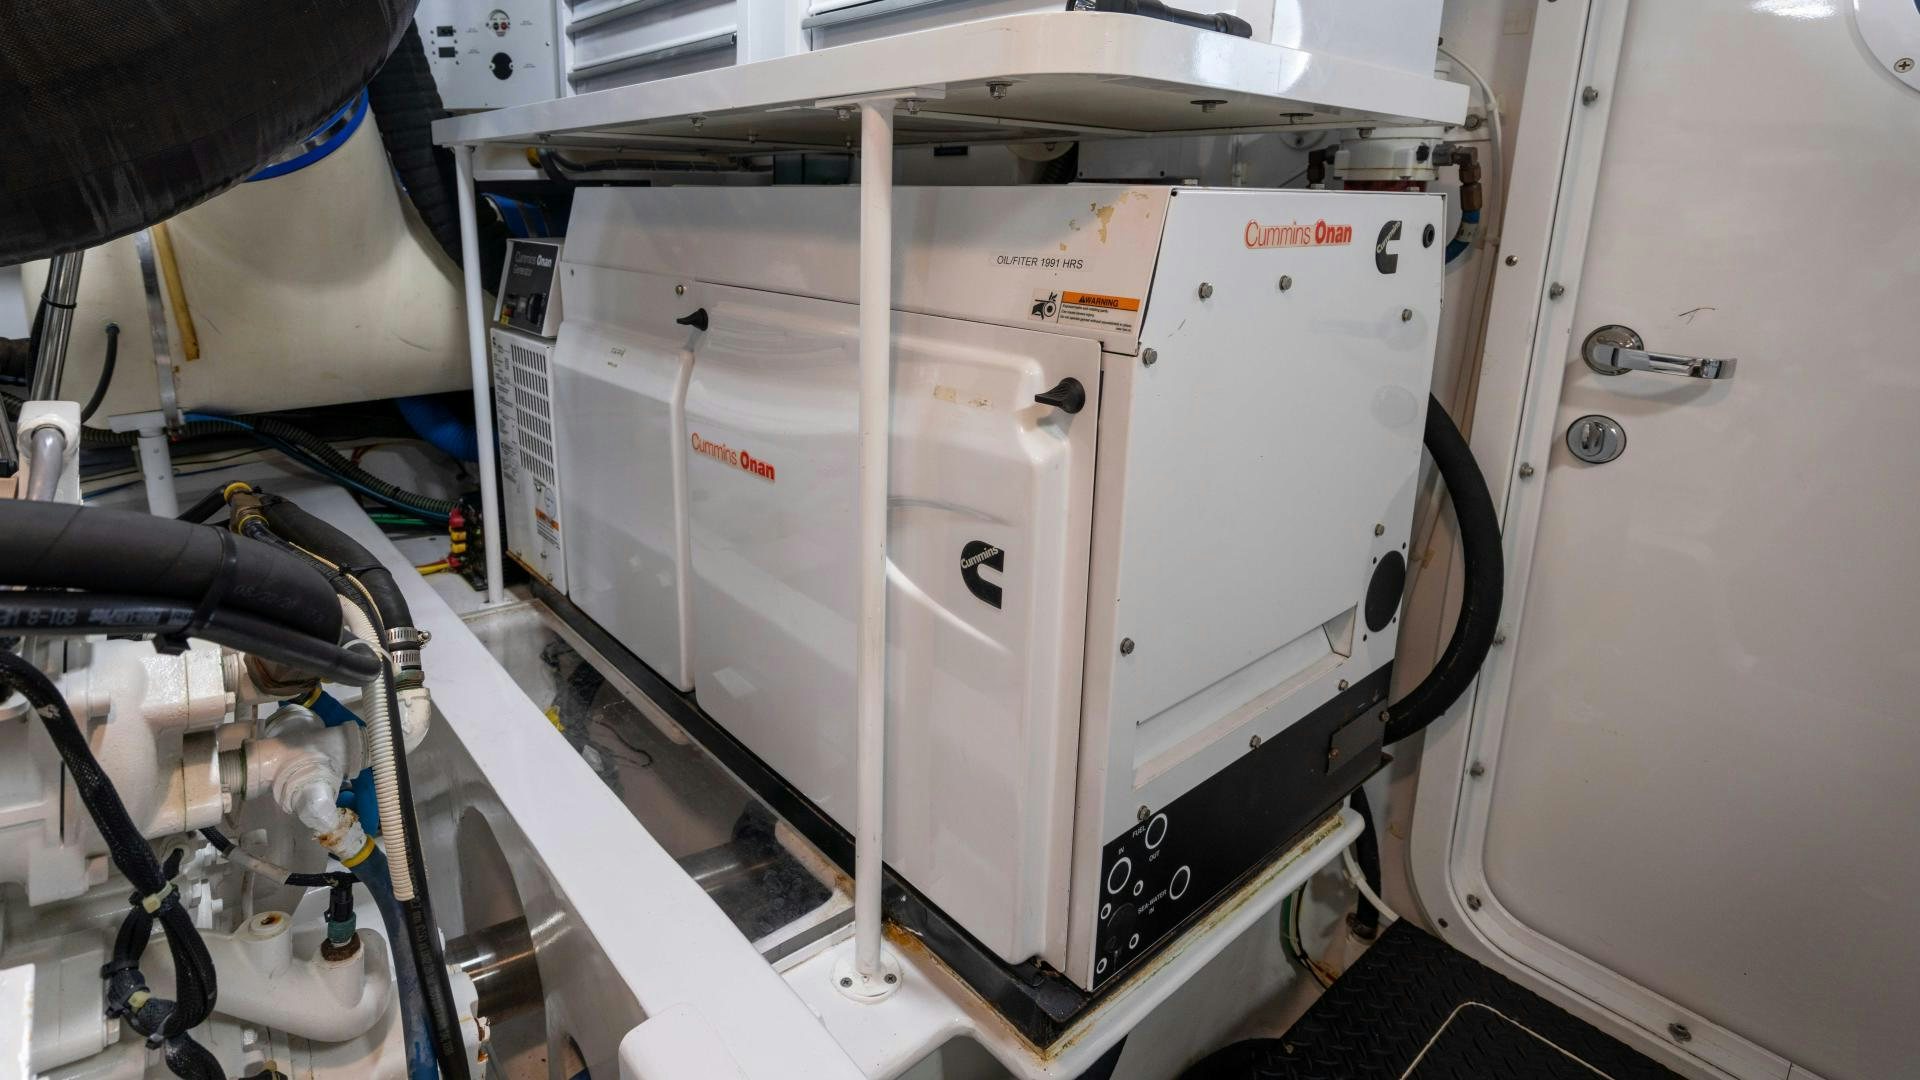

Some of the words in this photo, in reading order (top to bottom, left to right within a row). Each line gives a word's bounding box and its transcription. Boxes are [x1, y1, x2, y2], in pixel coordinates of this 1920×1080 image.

[1245, 221, 1311, 247] Cummins
[1314, 220, 1352, 244] Onan
[537, 254, 552, 268] Onan
[997, 255, 1038, 267] OIL/FITER
[1040, 258, 1060, 268] 1991
[1062, 259, 1084, 270] HRS
[1085, 296, 1119, 307] WARNING
[691, 432, 737, 466] Cummins
[740, 450, 775, 480] Onan
[960, 546, 999, 569] Cummins
[1132, 825, 1147, 838] FUEL
[1118, 845, 1125, 855] IN
[1148, 849, 1160, 862] OUT
